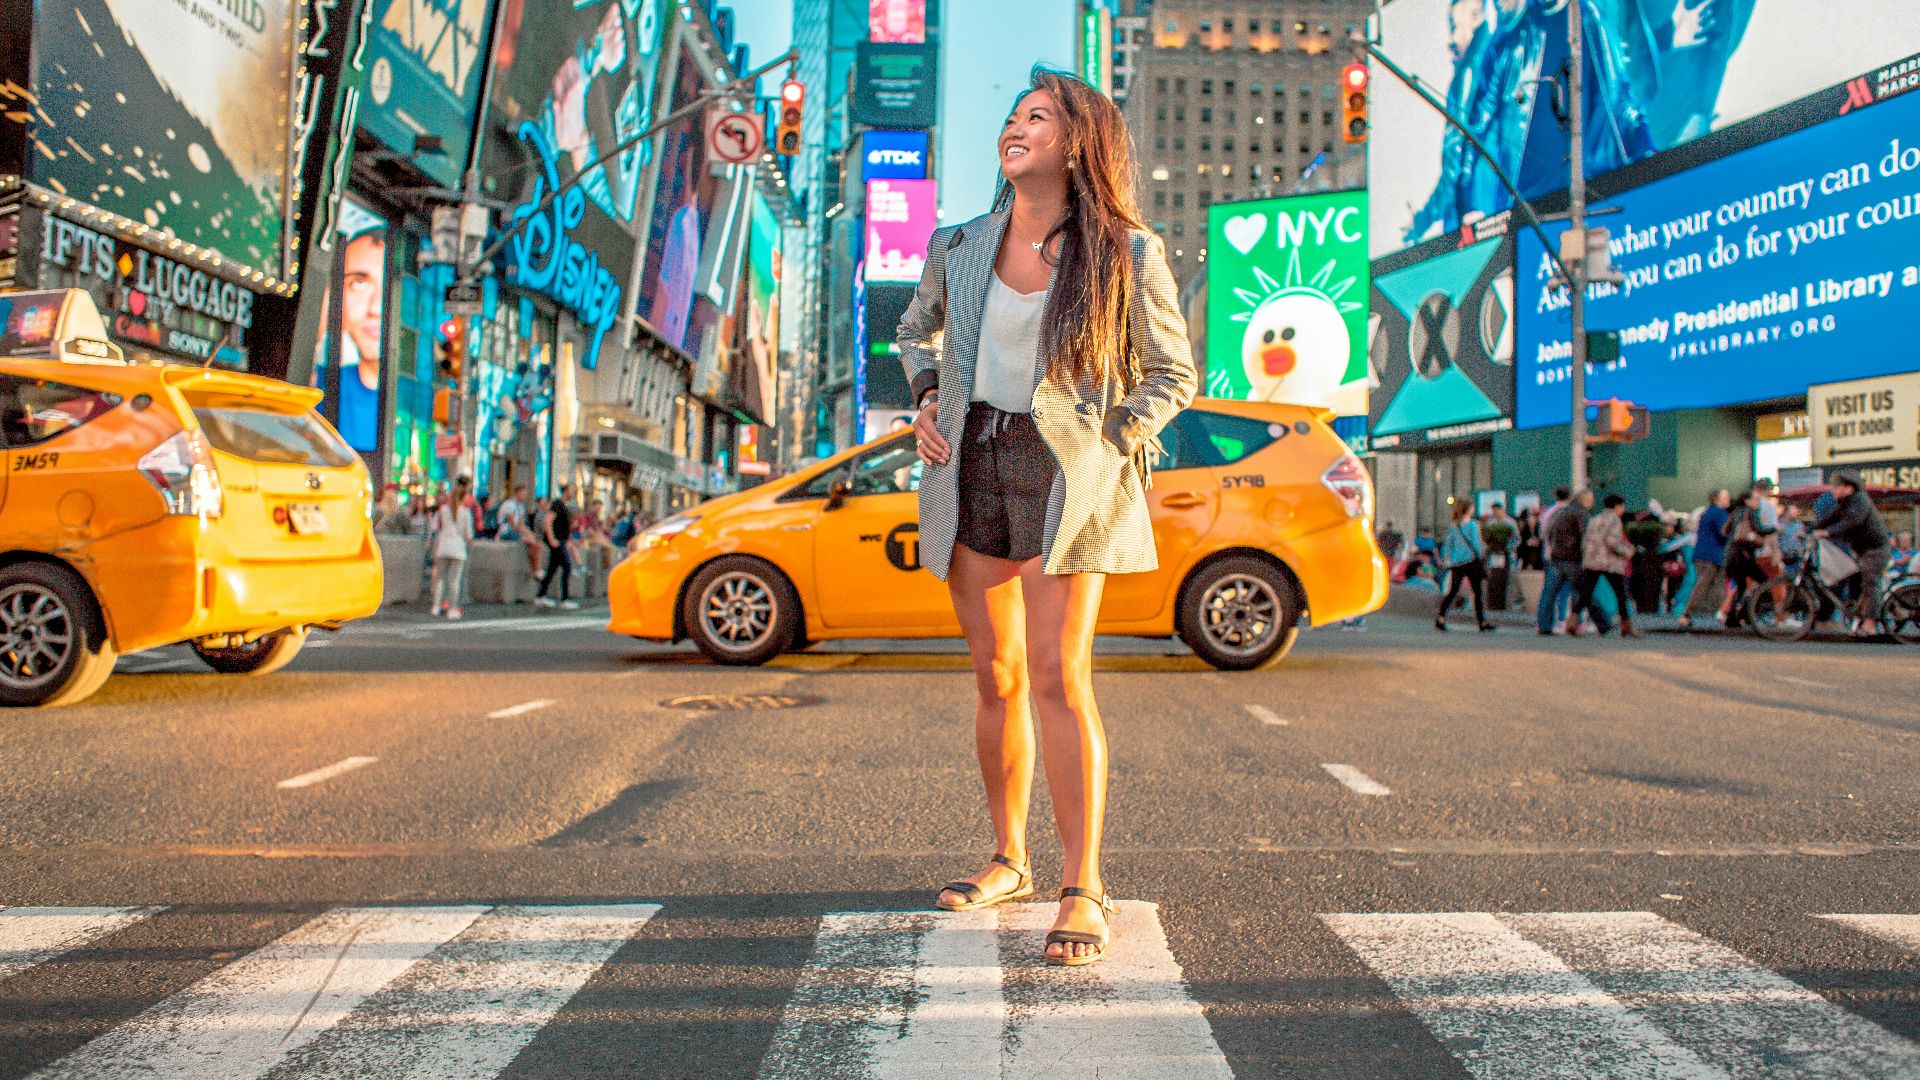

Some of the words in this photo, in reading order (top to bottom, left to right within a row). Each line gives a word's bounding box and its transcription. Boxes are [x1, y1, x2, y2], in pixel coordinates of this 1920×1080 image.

[881, 149, 921, 166] TDK
[1608, 223, 1659, 258] what
[1662, 209, 1713, 249] your
[1716, 178, 1815, 227] country
[1819, 161, 1871, 195] can
[1879, 138, 1920, 178] do
[1277, 206, 1363, 249] NYC
[1623, 263, 1660, 298] you
[1663, 252, 1702, 281] can
[1707, 233, 1740, 269] do
[1746, 224, 1782, 260] for
[1787, 211, 1851, 256] your
[134, 248, 254, 329] LUGGAGE
[1673, 285, 1799, 336] Presidential
[1805, 270, 1894, 308] Library
[168, 330, 213, 358] SONY
[1826, 392, 1867, 417] VISIT
[1869, 389, 1894, 412] US
[1826, 420, 1856, 439] NEXT
[1858, 416, 1894, 436] DOOR
